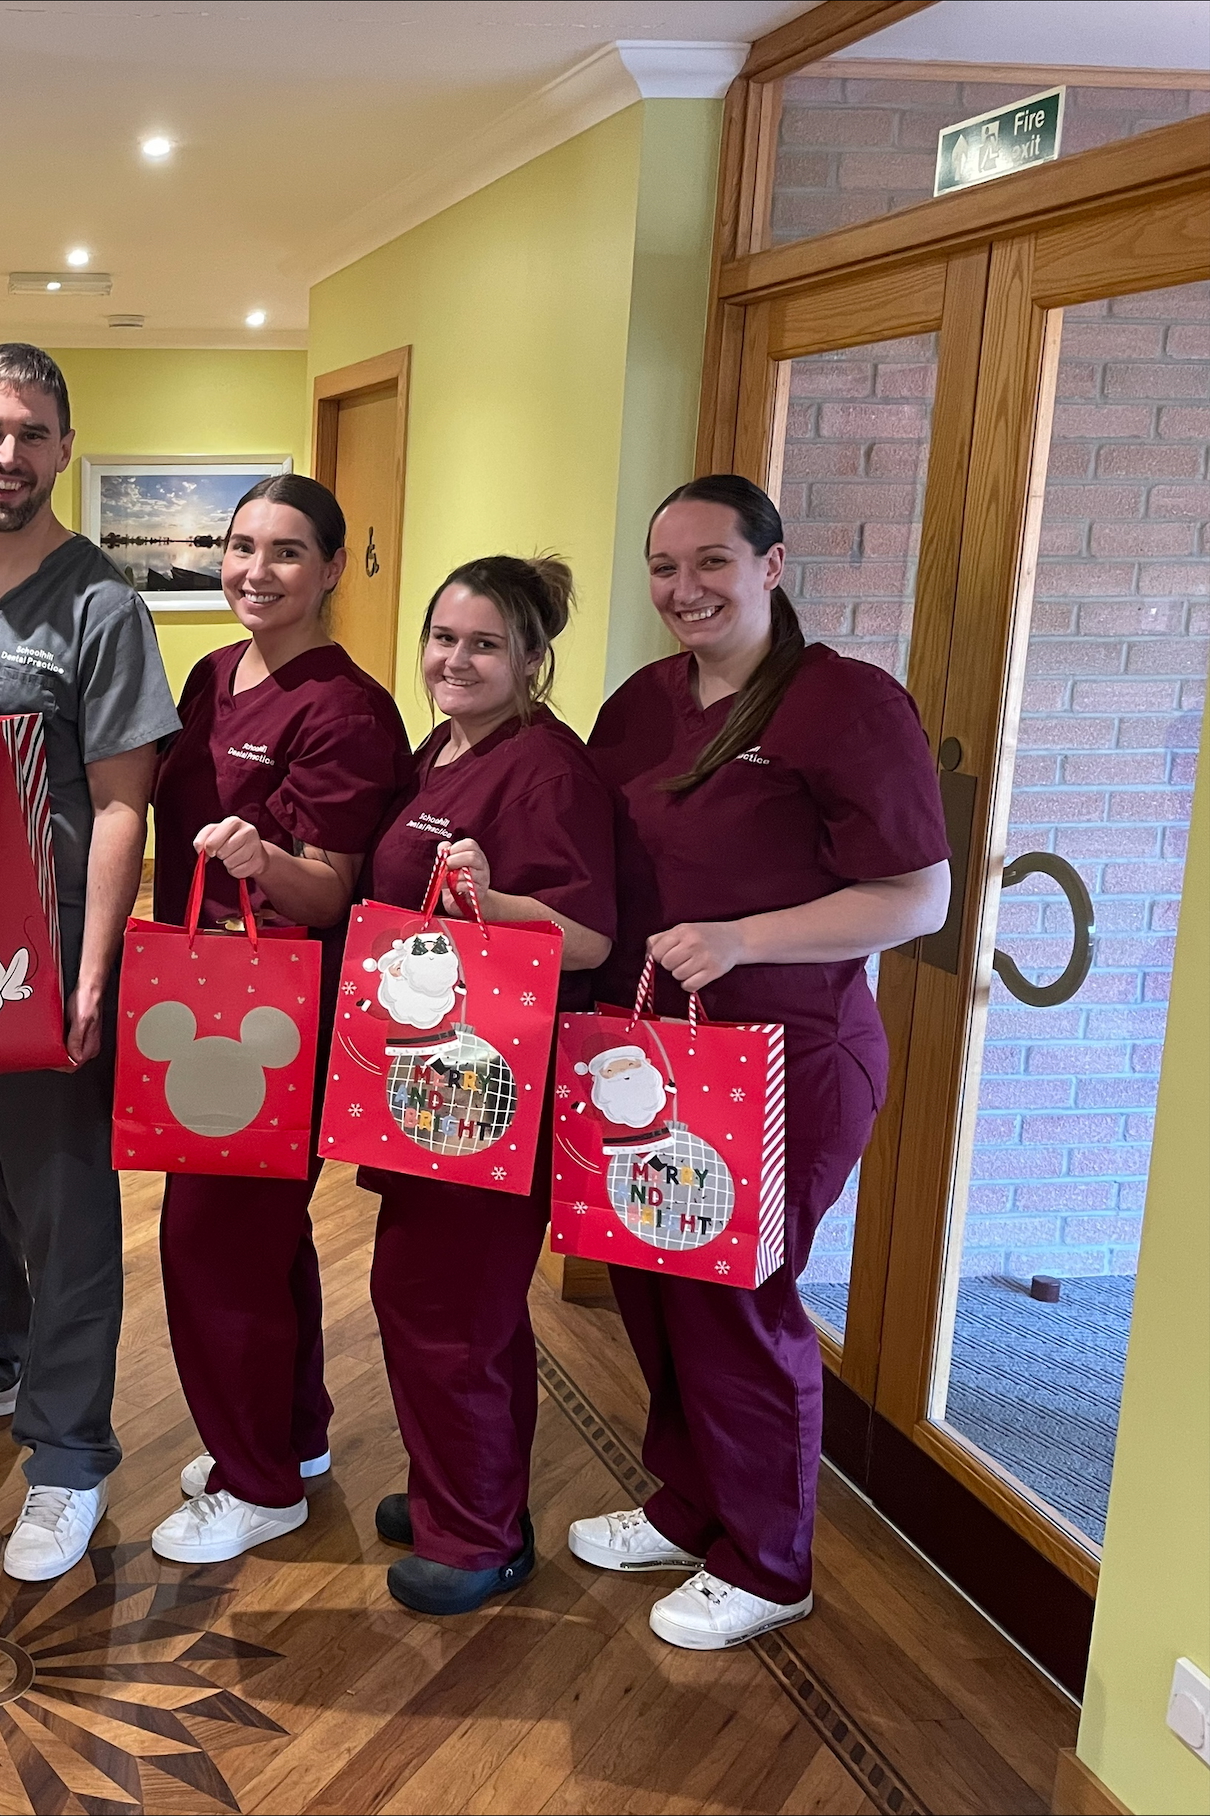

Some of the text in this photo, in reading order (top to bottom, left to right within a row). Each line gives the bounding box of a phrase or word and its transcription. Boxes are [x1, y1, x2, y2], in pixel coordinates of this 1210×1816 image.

[1013, 109, 1046, 136] Fire
[1011, 134, 1041, 160] exit
[1, 651, 65, 675] Dental Practice
[16, 645, 55, 662] Schoolhill
[394, 1084, 444, 1111] AND
[403, 1107, 492, 1141] BRIGHT
